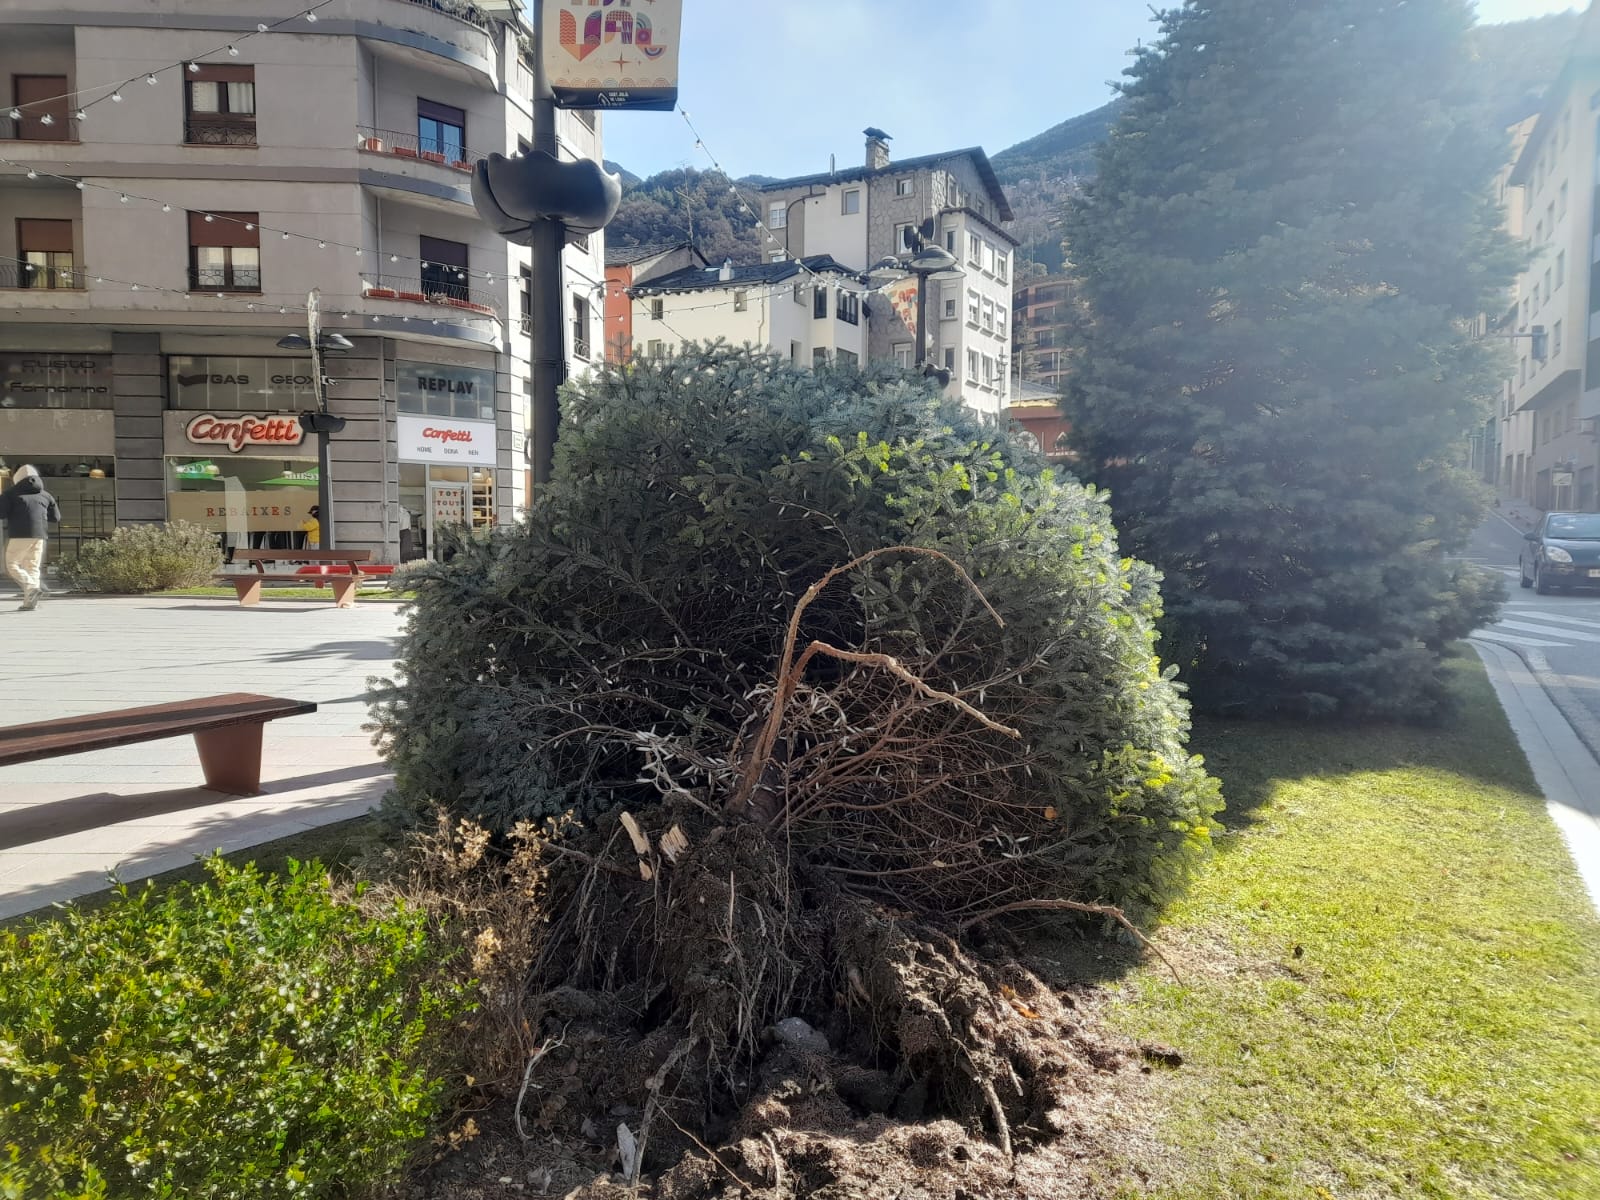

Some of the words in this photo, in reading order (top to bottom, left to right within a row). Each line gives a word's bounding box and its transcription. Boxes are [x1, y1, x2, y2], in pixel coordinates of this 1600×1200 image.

[210, 374, 249, 385] GAS
[418, 376, 474, 395] REPLAY
[191, 418, 299, 448] Confetti
[422, 427, 473, 443] Confetti
